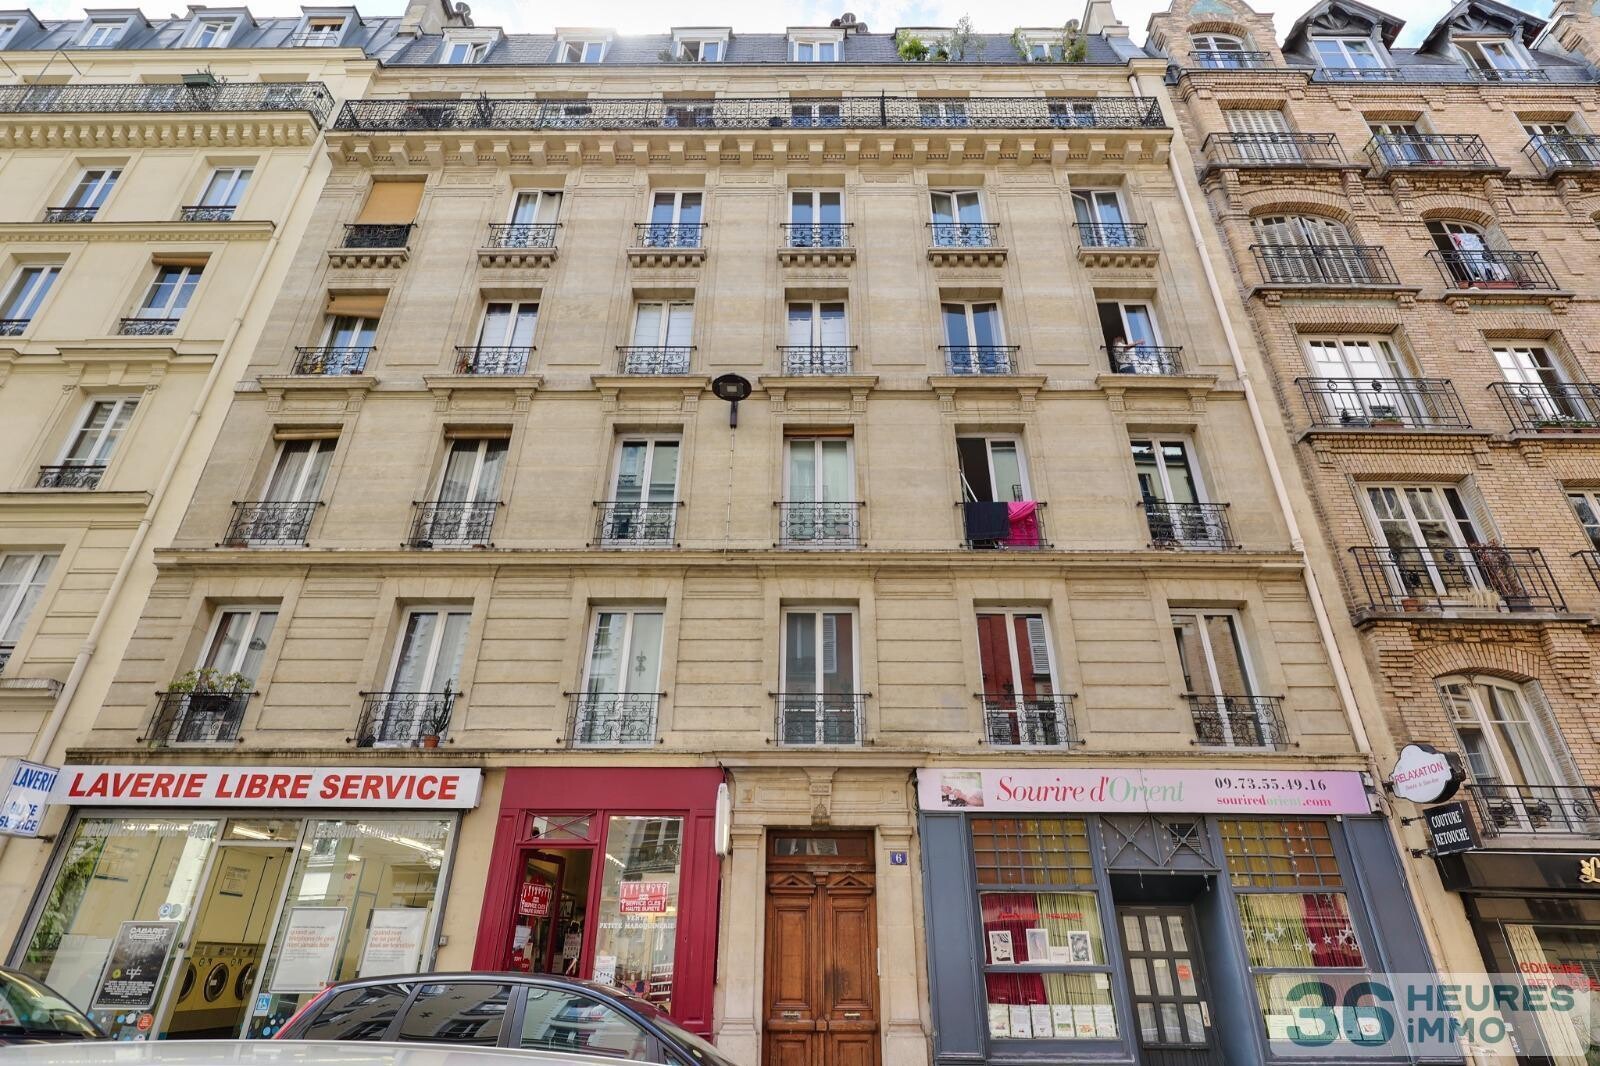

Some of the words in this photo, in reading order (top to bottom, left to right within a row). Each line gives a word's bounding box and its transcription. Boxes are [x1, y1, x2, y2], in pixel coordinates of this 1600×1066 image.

[1394, 762, 1445, 784] RELAXATION
[68, 773, 207, 798] LAVERIE
[215, 774, 313, 799] LIBRE
[319, 775, 460, 800] SERVICE
[996, 776, 1084, 802] Sourire
[1089, 776, 1184, 802] d'Orient
[1215, 777, 1327, 791] 09.73.55.49.16
[1216, 794, 1332, 807] souriredorient.com
[1431, 810, 1462, 828] COUTURE
[1434, 827, 1470, 846] RETOUCHE
[895, 853, 903, 863] 6
